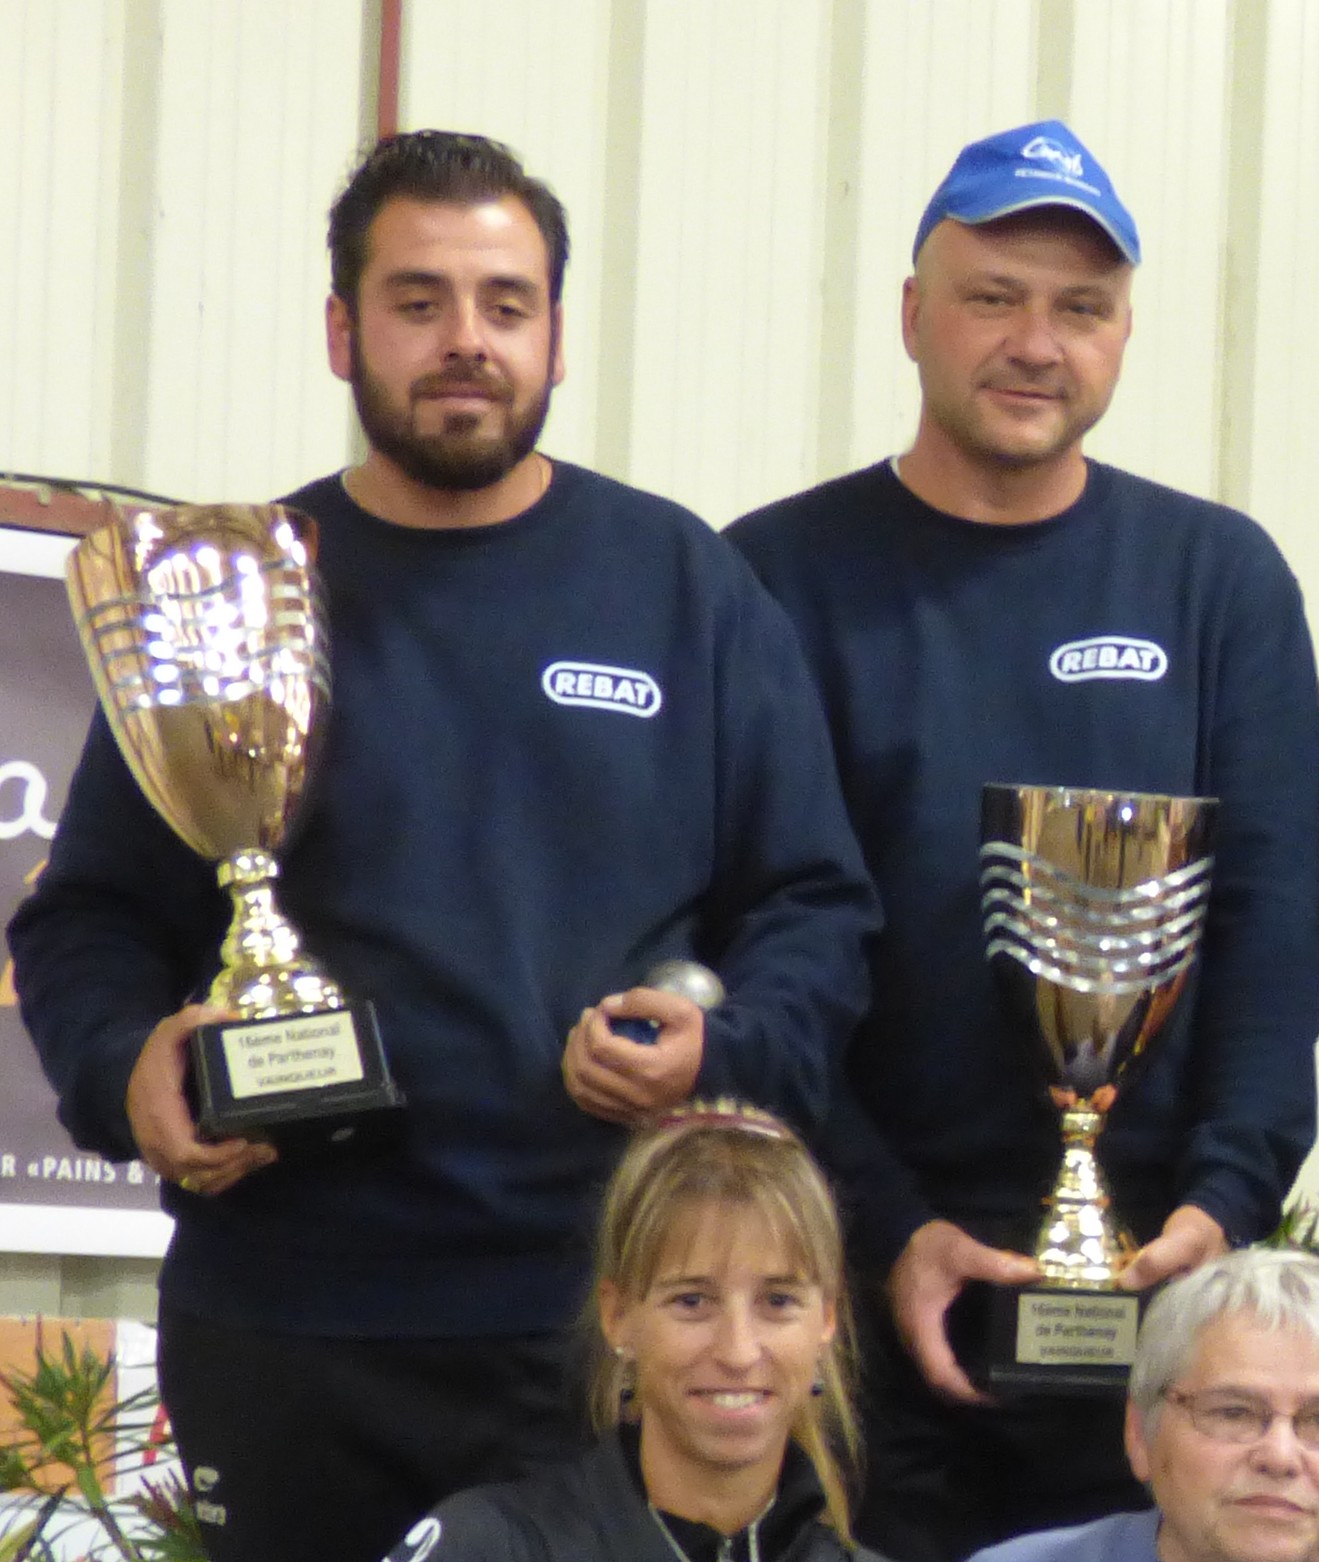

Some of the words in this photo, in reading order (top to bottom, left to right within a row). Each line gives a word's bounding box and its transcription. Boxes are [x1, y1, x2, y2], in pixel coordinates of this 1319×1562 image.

[1060, 645, 1157, 673] REBAT
[555, 671, 652, 706] REBAT
[285, 1023, 340, 1041] National
[248, 1053, 264, 1068] de
[268, 1048, 335, 1065] Parthenay
